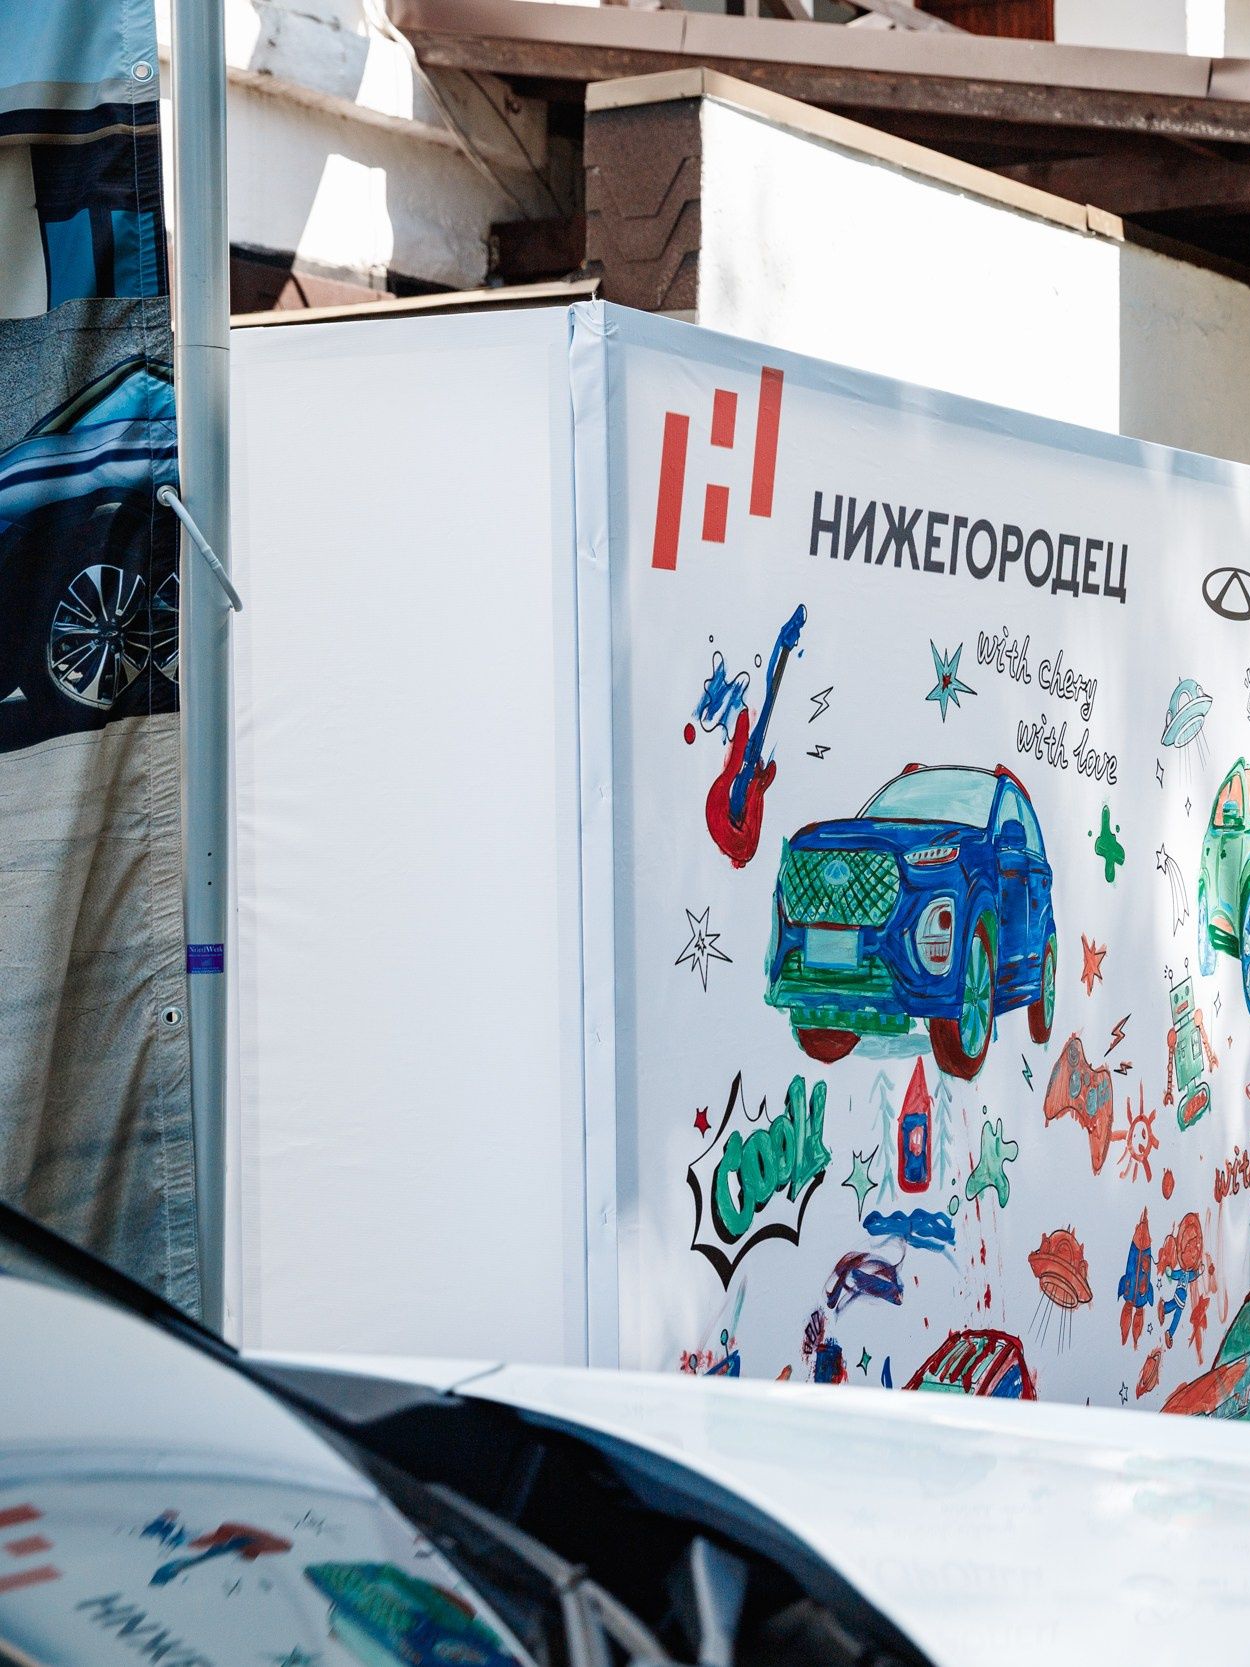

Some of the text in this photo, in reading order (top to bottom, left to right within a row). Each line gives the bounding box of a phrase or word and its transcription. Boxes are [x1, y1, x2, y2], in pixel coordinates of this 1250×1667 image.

[809, 490, 1129, 604] НИЖЕГОРОДЕЦ
[977, 625, 1097, 721] with chery
[1017, 713, 1117, 785] with love
